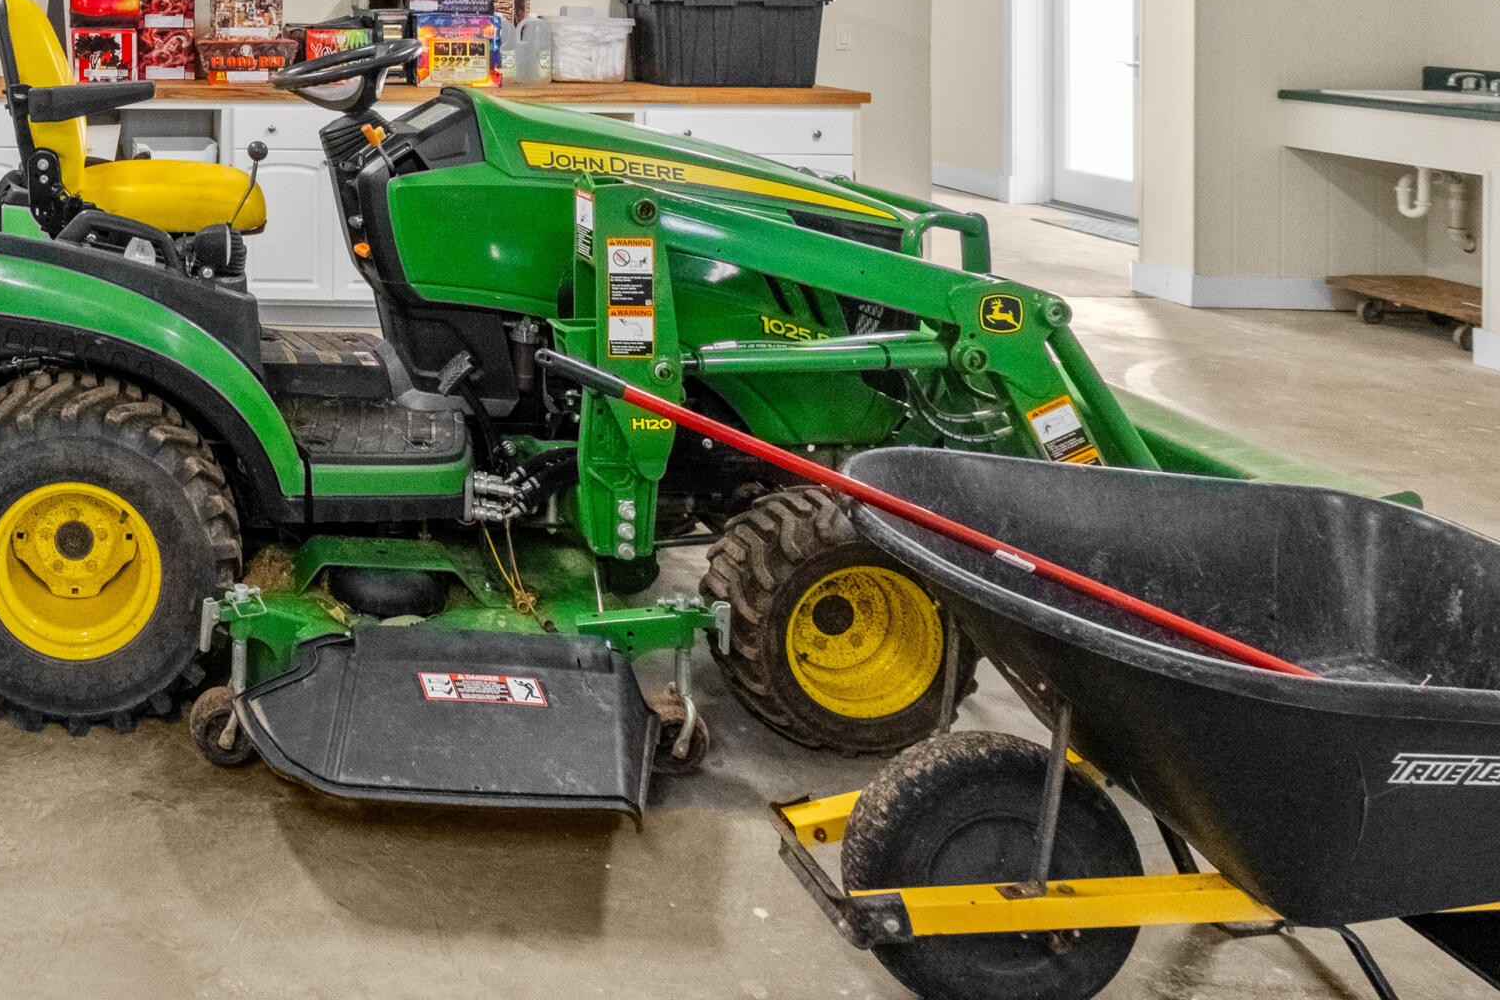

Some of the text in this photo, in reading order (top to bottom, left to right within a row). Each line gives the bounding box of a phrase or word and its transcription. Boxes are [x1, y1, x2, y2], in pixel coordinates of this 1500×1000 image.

[543, 151, 686, 182] JOHN DEERE
[616, 239, 651, 247] WARNING
[617, 309, 652, 317] WARNING
[632, 418, 672, 430] H120
